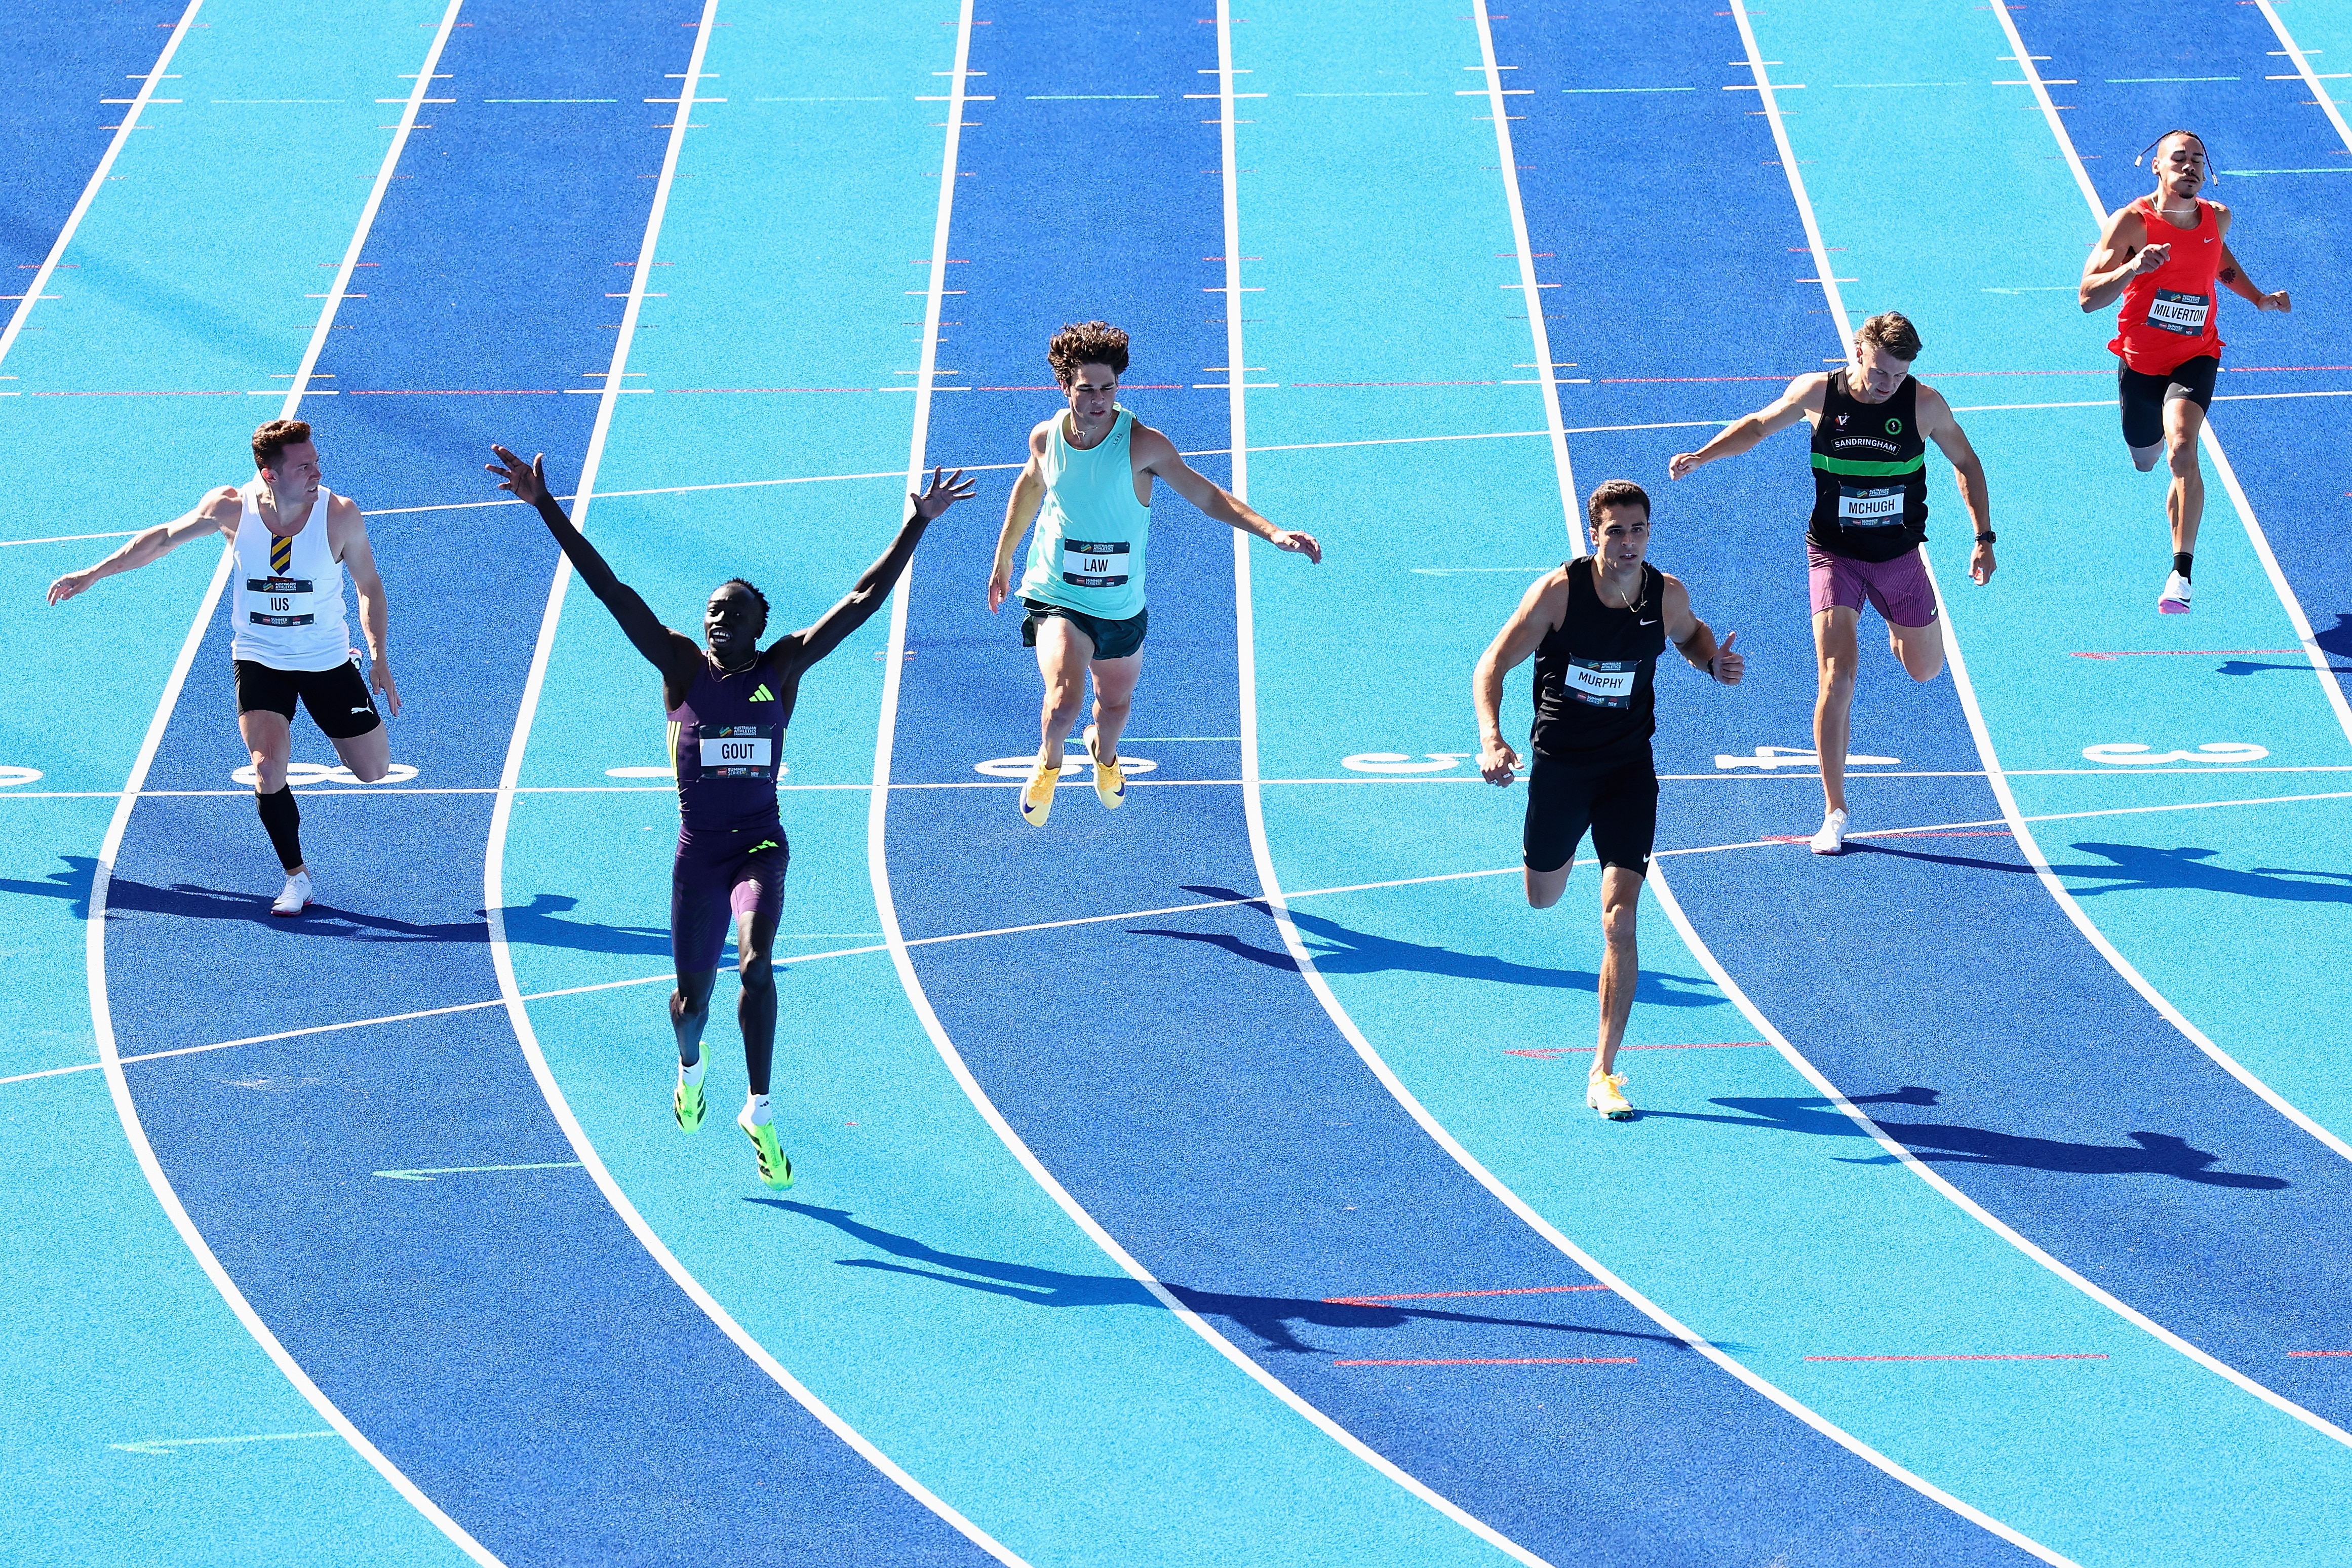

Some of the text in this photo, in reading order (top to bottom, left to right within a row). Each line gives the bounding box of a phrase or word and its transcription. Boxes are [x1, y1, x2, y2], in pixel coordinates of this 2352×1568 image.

[2153, 303, 2205, 322] MILVERTON
[1834, 439, 1896, 452] SANDRINGHAM
[1849, 499, 1895, 514] MCHUGH
[1084, 558, 1108, 572] LAW
[270, 597, 289, 611] IUS
[1578, 671, 1624, 688] MURPHY
[722, 743, 755, 759] GOUT
[1714, 746, 1900, 770] 4
[2082, 742, 2269, 765] 3
